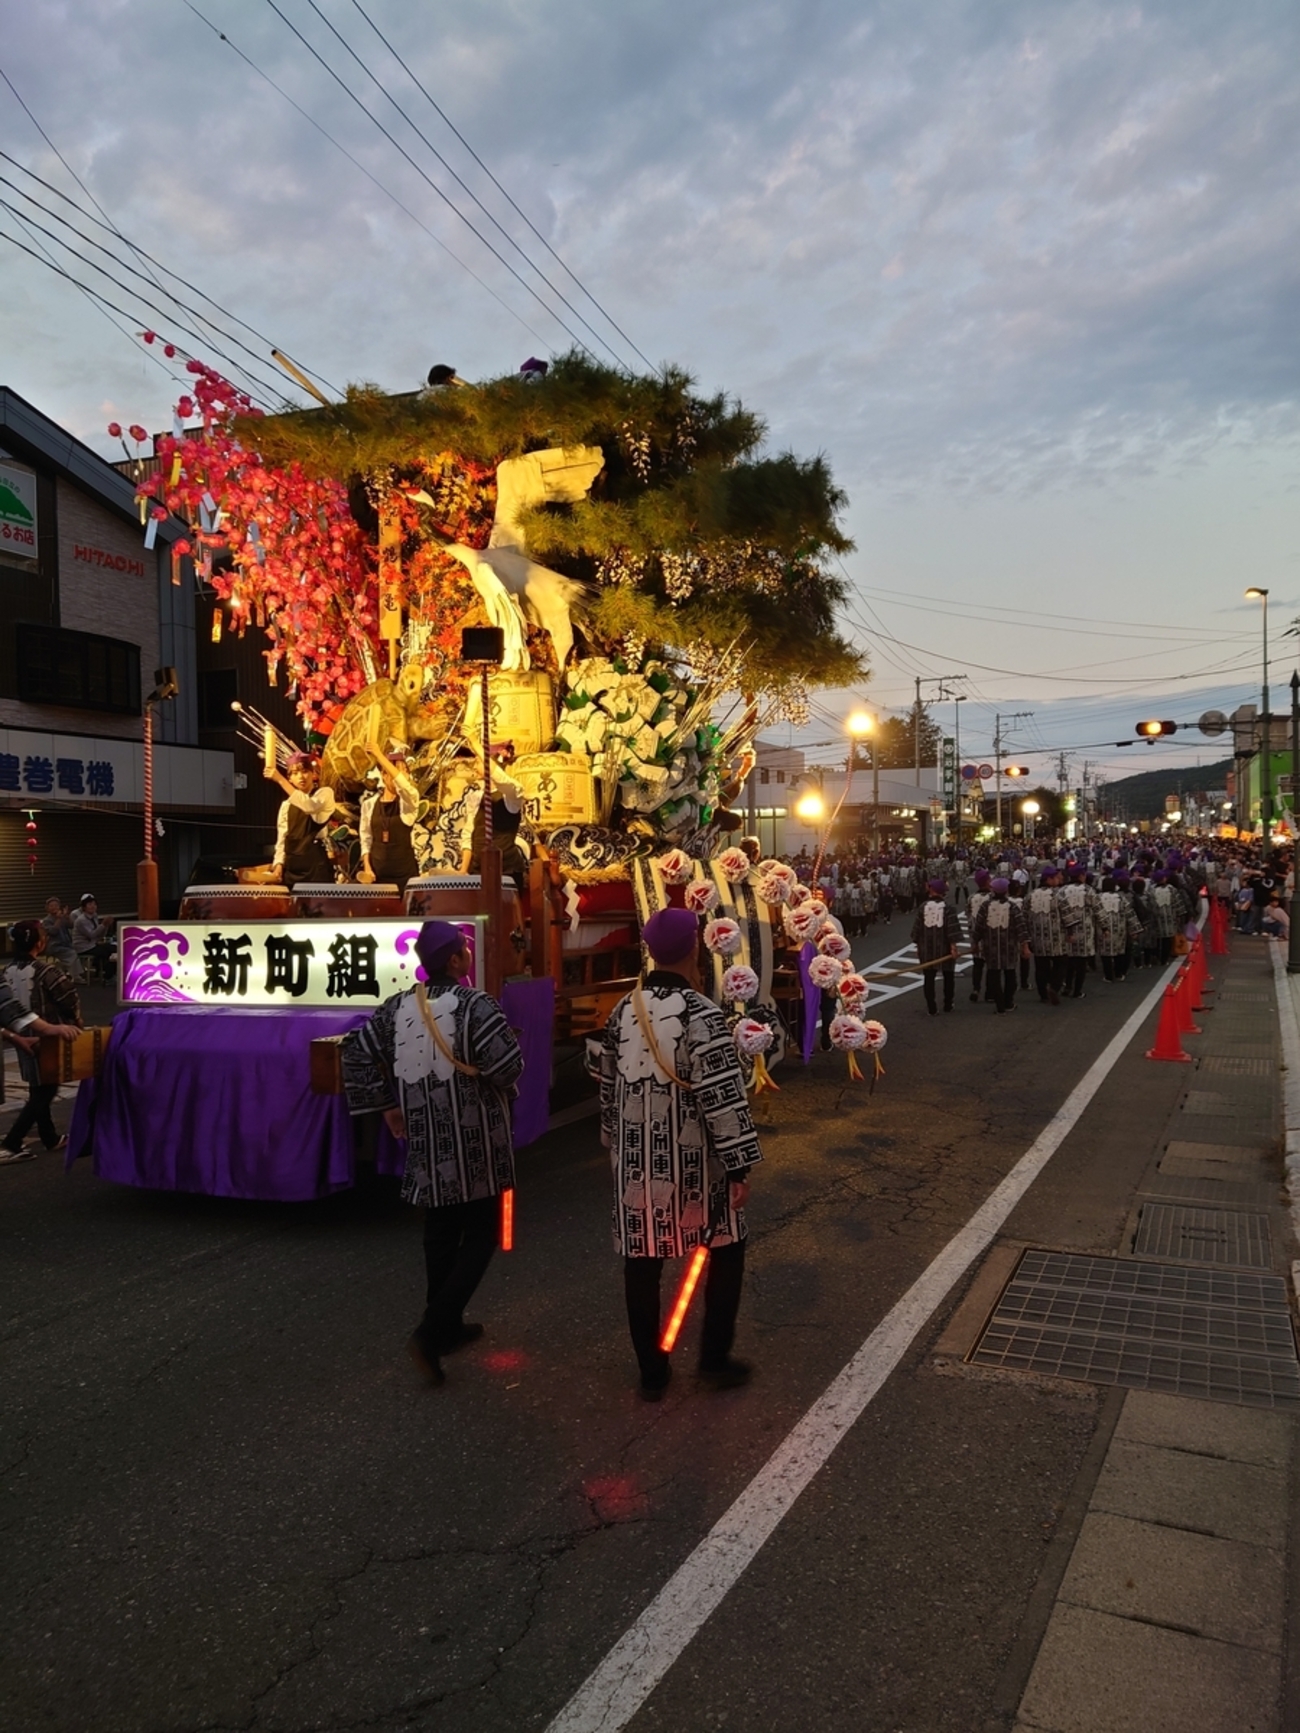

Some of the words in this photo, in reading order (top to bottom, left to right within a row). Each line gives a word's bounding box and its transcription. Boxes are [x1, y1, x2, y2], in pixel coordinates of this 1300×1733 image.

[74, 544, 144, 577] HITACHI
[202, 932, 380, 998] 新町組
